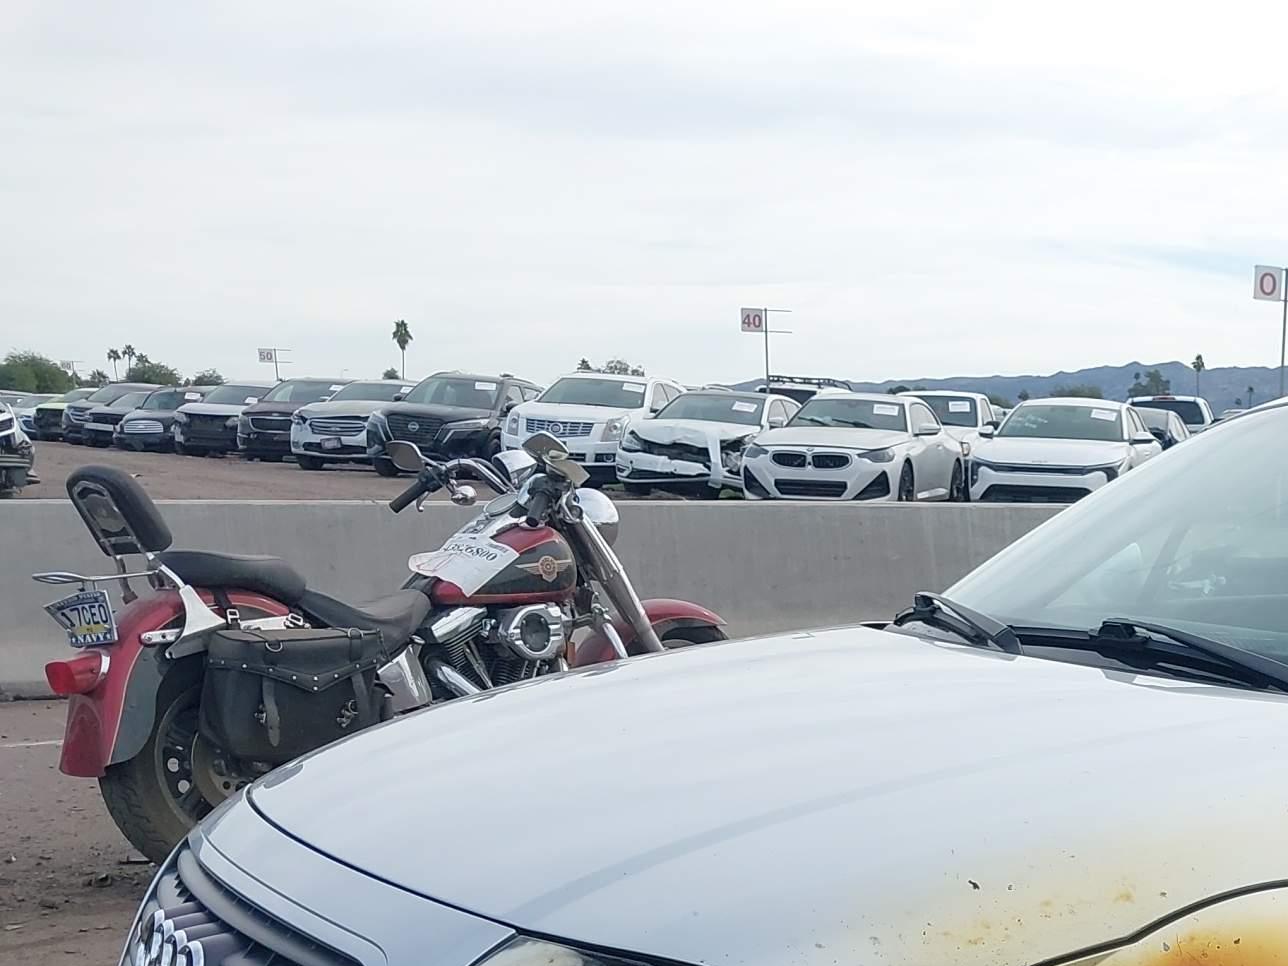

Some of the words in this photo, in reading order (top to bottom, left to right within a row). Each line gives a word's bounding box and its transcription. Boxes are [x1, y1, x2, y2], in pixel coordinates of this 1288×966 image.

[1259, 272, 1277, 297] O
[742, 313, 762, 329] 40
[259, 351, 272, 361] 50
[443, 543, 498, 561] 6800
[77, 632, 104, 643] NAVY
